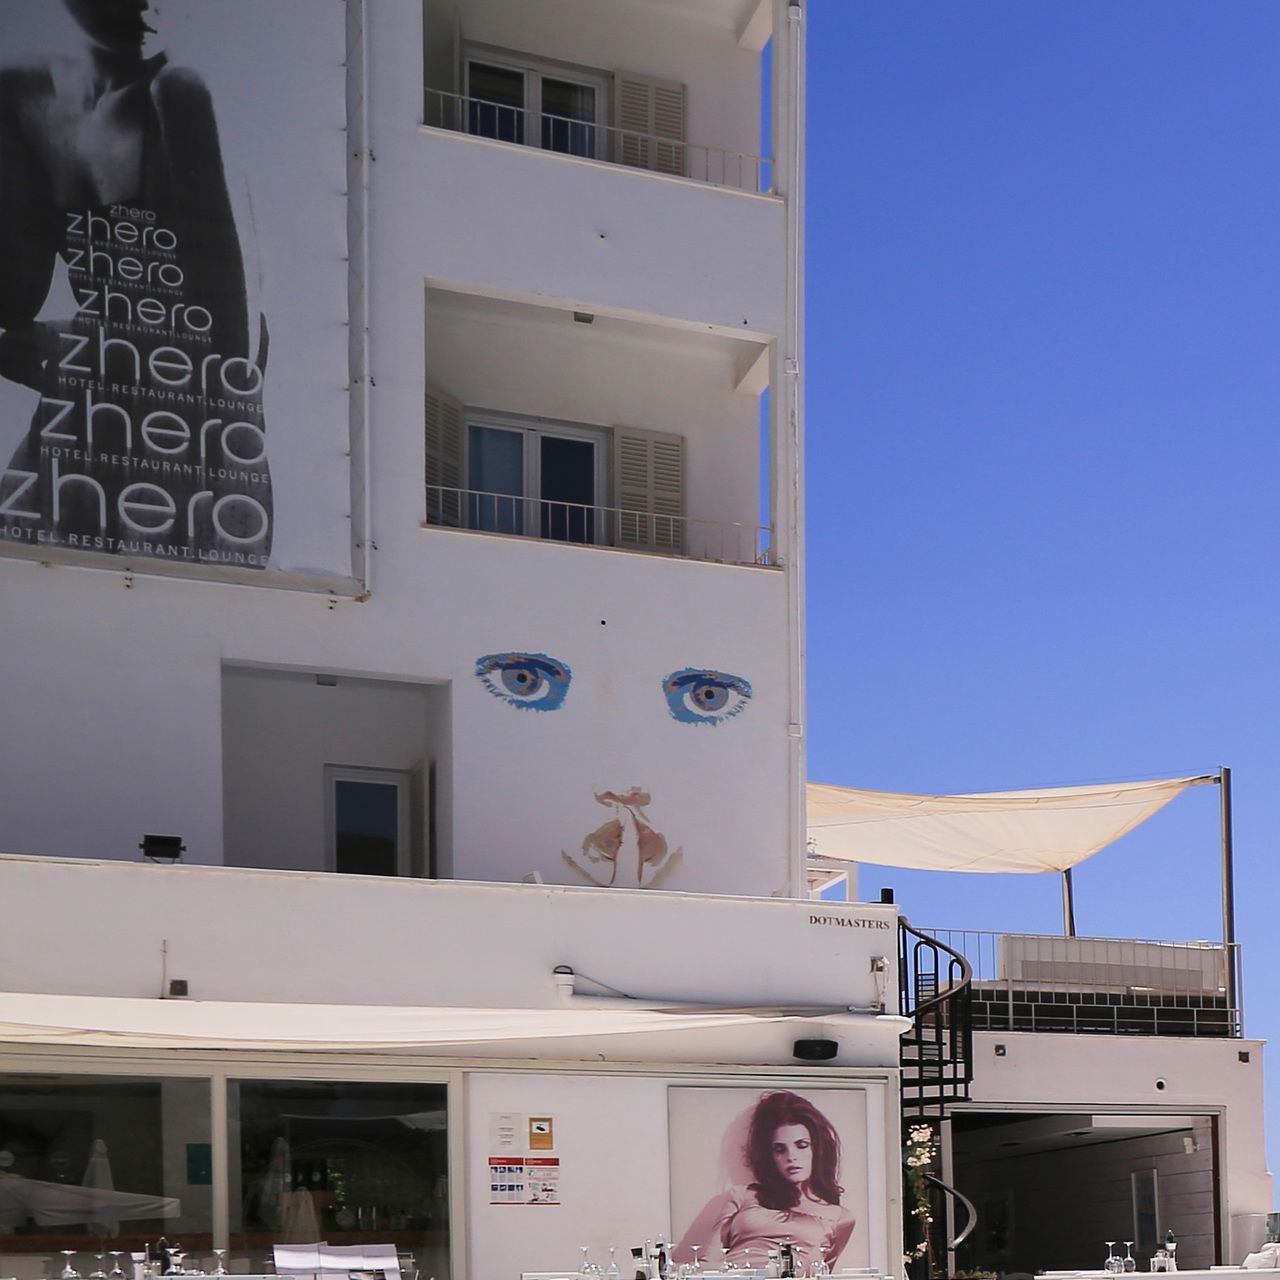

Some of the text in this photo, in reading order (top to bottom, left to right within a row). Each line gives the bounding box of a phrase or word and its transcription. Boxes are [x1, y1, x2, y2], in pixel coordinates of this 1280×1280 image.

[66, 210, 177, 250] zhero
[110, 203, 157, 222] zhero
[67, 245, 184, 287] zhero
[78, 284, 213, 331] zhero
[59, 326, 263, 395] zhero
[40, 389, 267, 464] zhero
[0, 458, 269, 544] zhero
[809, 915, 890, 929] DOTMASTERS
